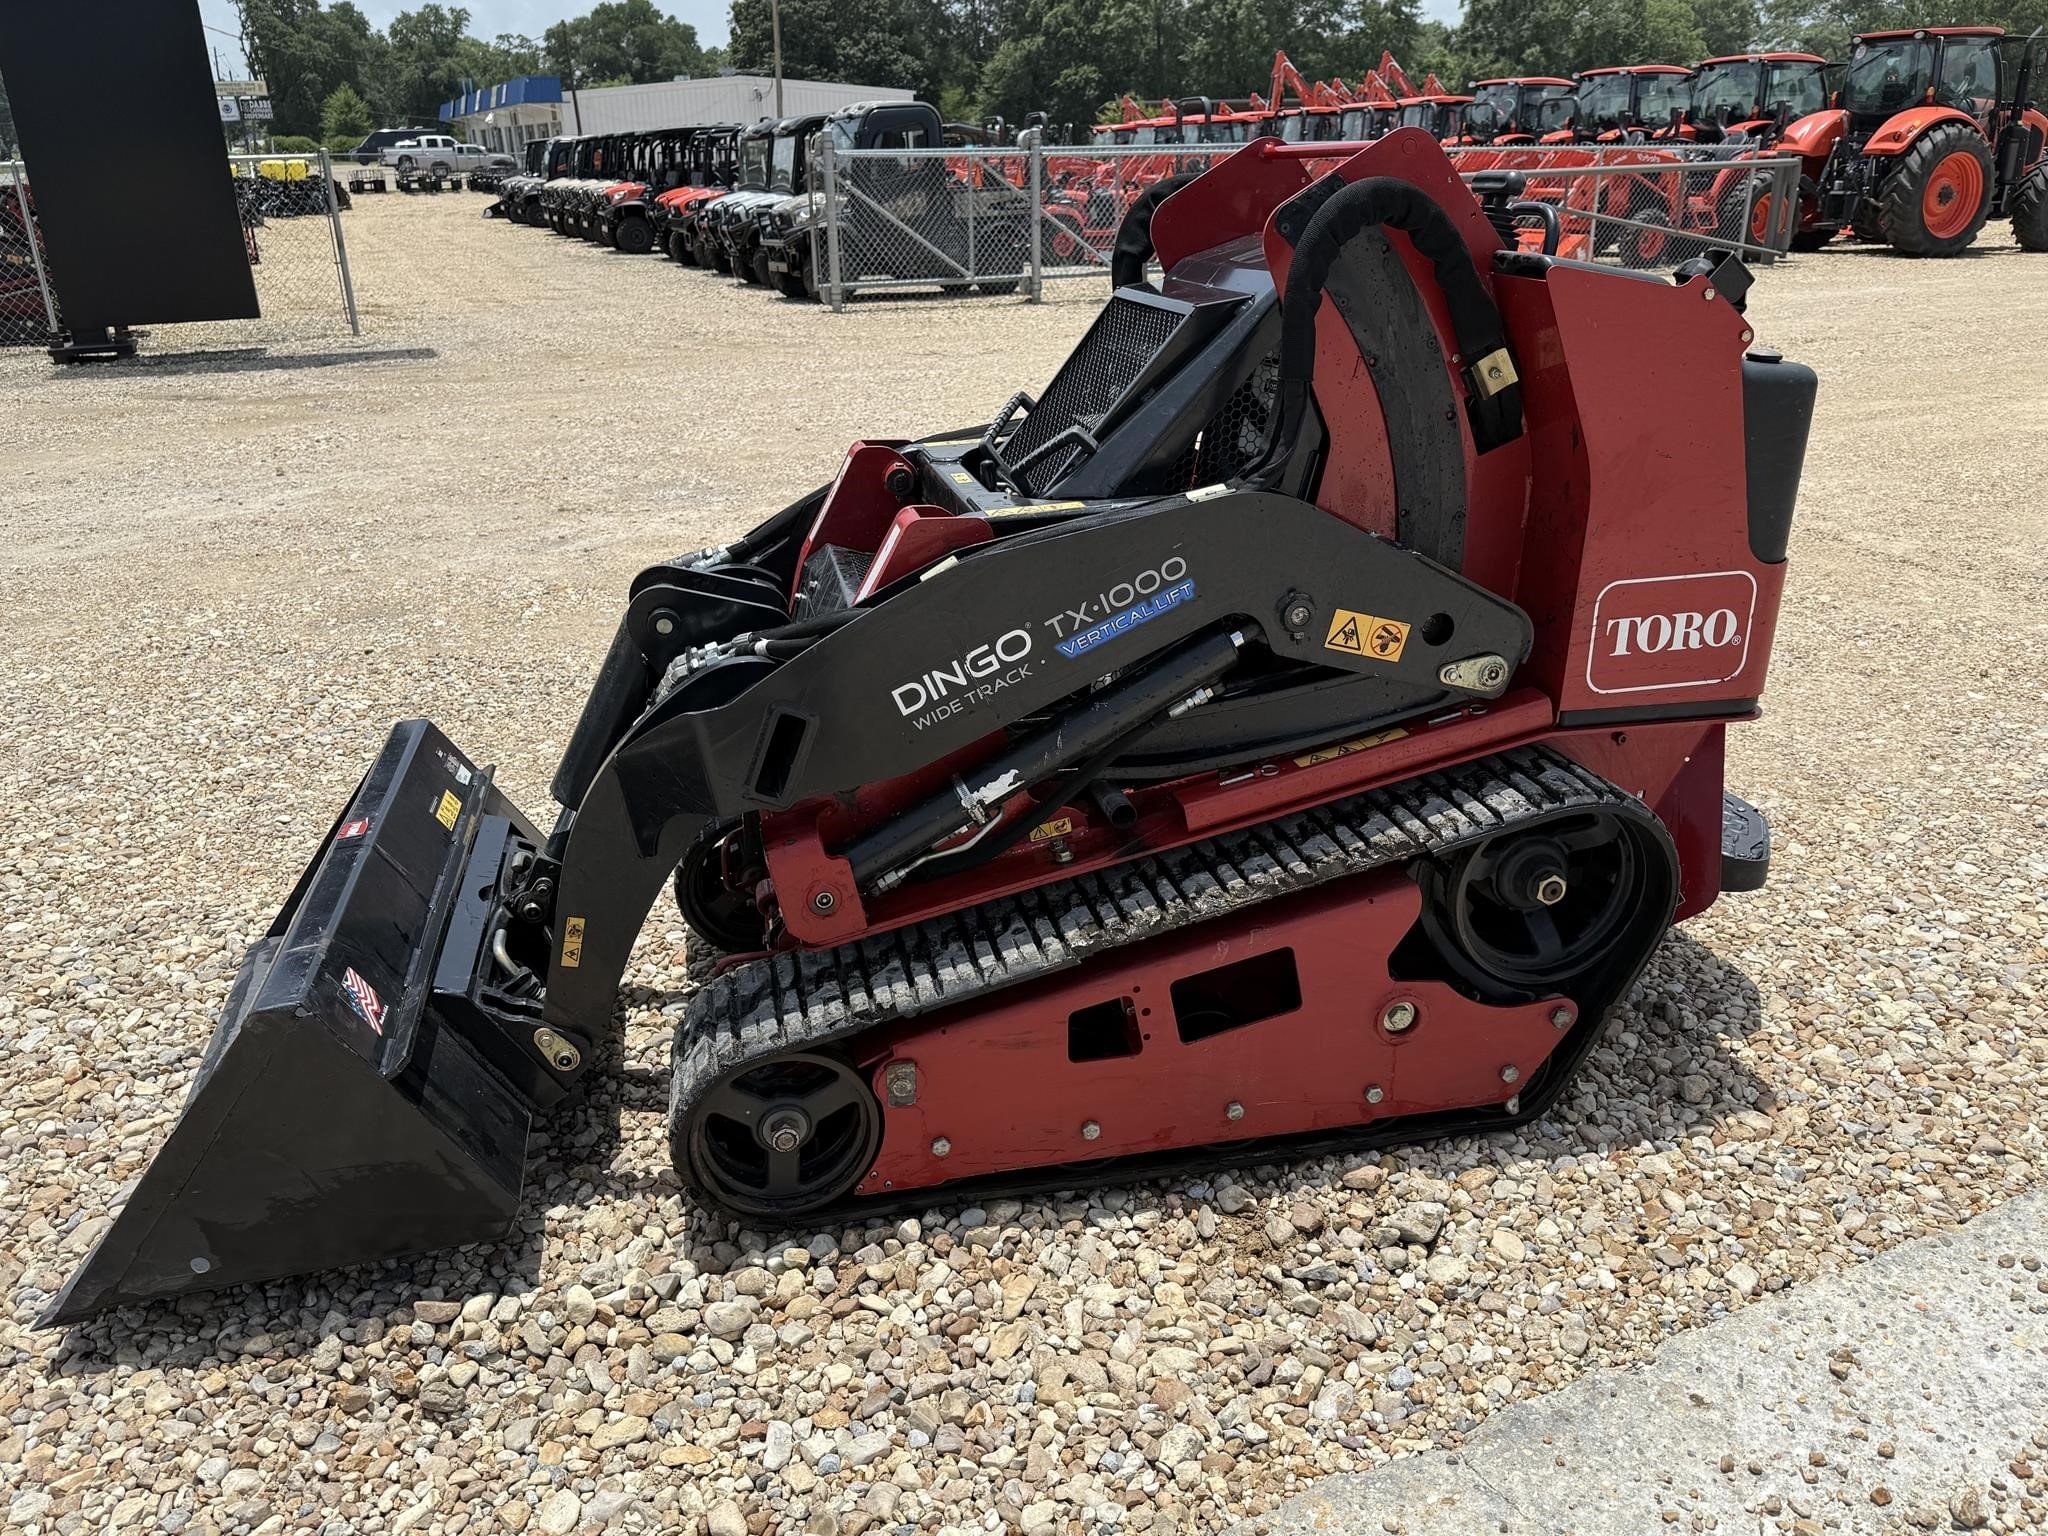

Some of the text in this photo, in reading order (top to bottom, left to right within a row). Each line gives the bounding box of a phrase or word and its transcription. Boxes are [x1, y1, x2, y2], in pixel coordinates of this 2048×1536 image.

[1062, 584, 1192, 655] VERTICAL LIFT
[912, 664, 1032, 730] WIDE TRACK
